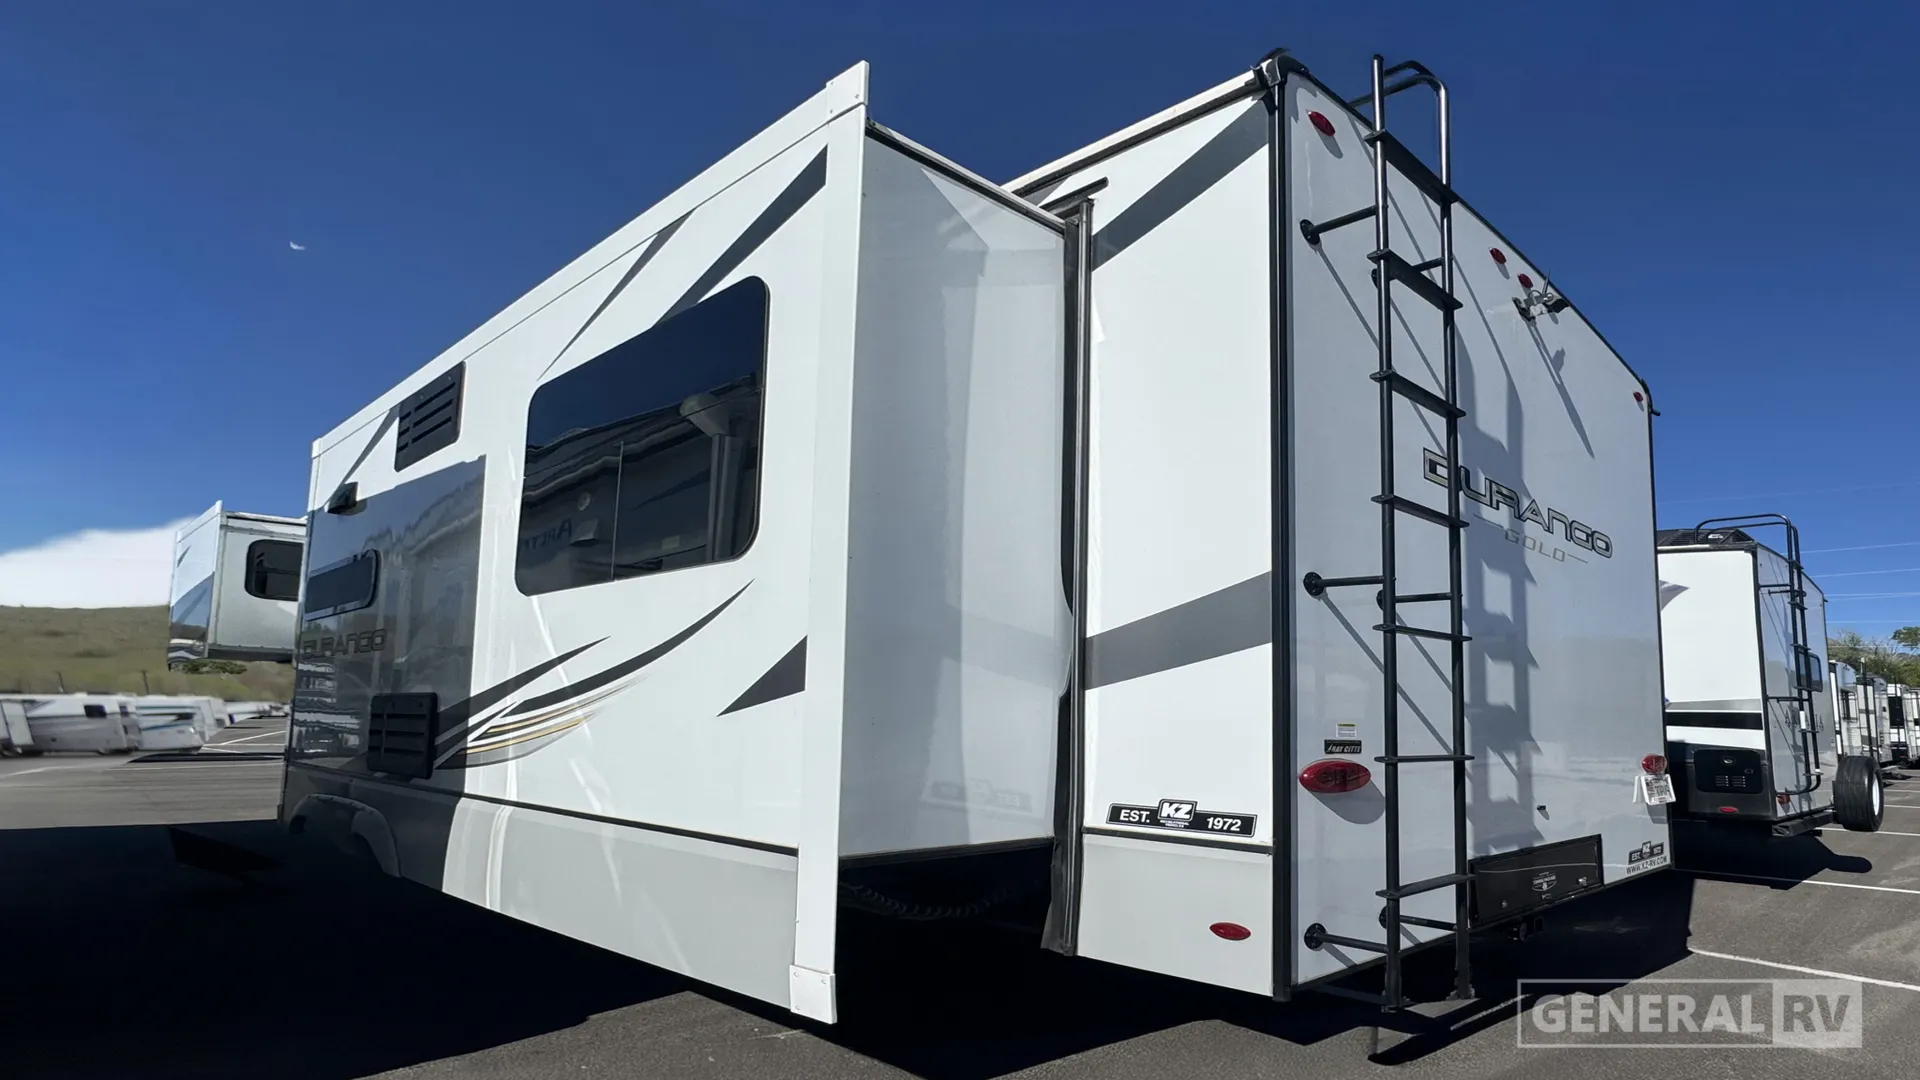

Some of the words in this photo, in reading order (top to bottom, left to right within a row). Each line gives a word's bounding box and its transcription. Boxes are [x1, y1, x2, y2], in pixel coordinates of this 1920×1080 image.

[1423, 447, 1613, 558] DURANGO
[1505, 528, 1566, 562] GOLD
[1119, 809, 1150, 823] EST.
[1161, 802, 1193, 819] KZ
[1206, 816, 1242, 831] 1972
